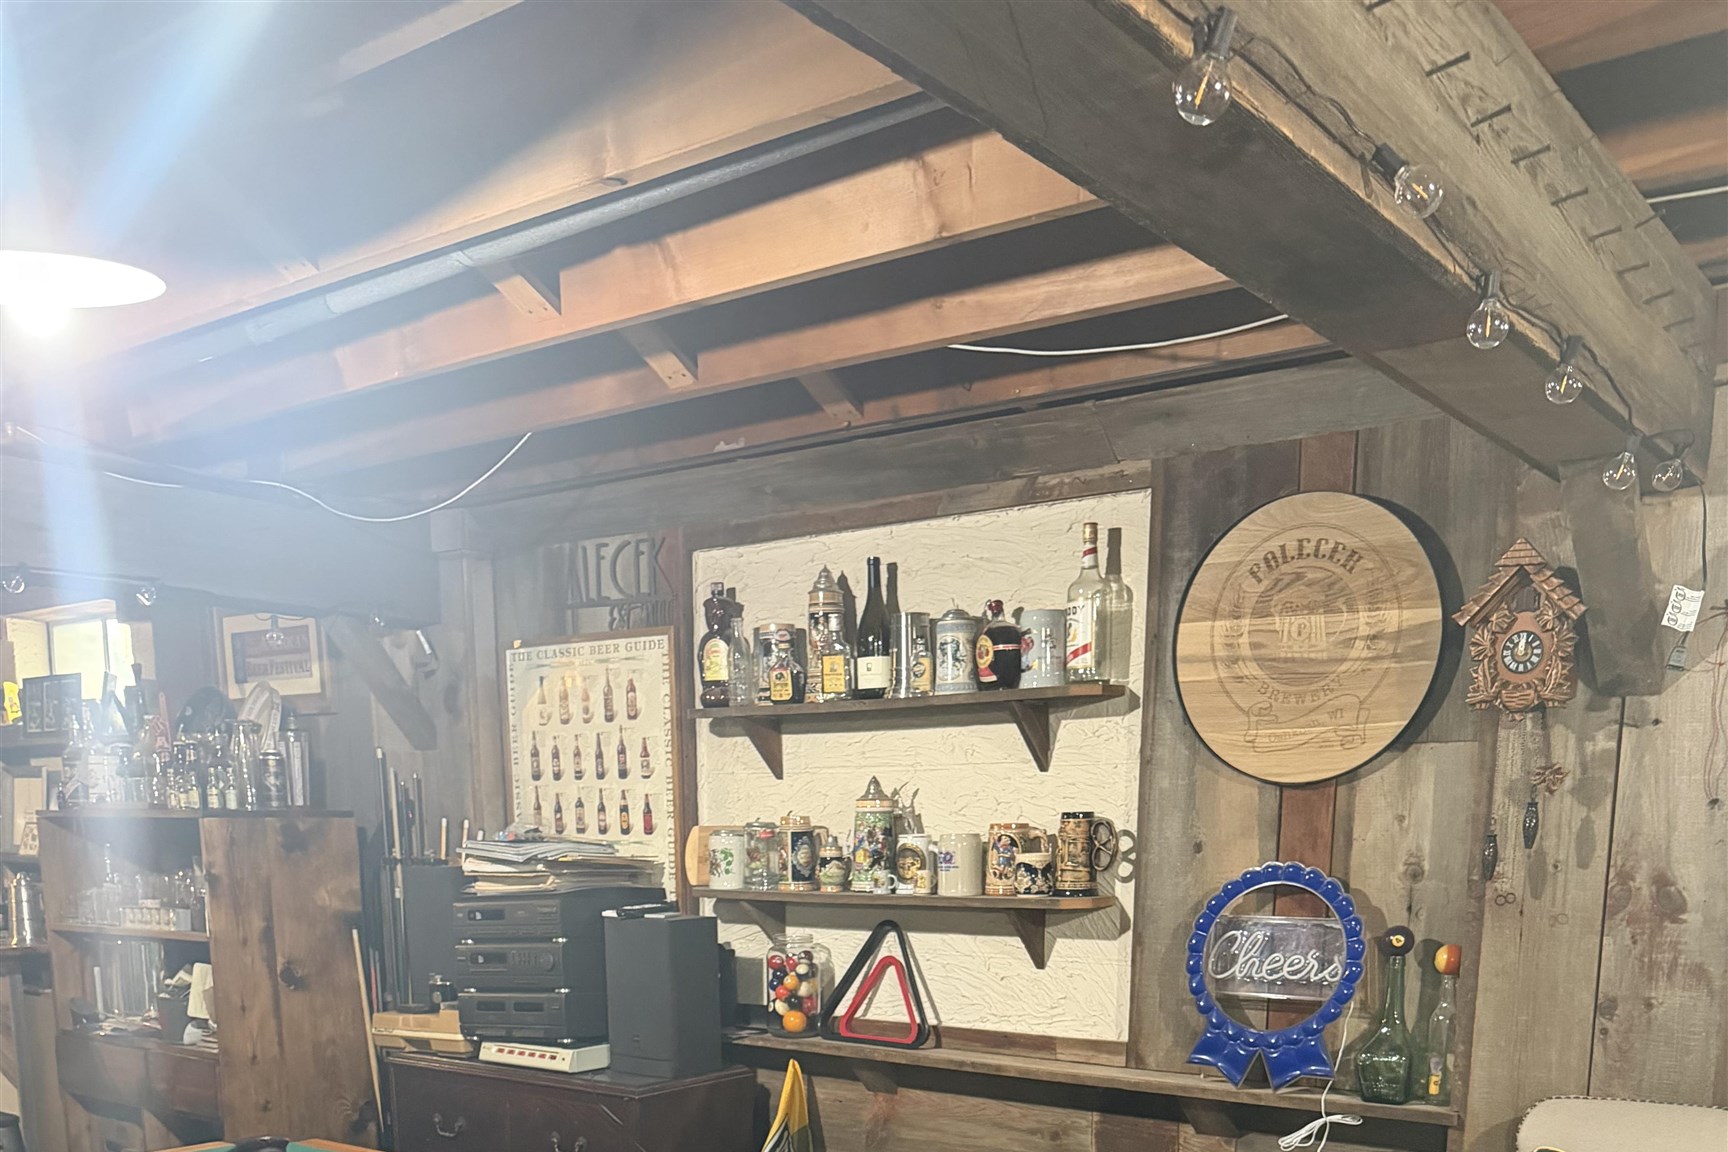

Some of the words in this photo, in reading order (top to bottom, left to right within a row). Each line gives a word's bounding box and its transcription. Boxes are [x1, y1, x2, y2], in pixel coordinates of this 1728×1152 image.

[536, 645, 585, 660] CLASSIC
[589, 642, 620, 656] BEER
[624, 638, 665, 653] GUIDE
[662, 693, 673, 767] CLASSIC
[665, 776, 675, 819] BEER
[666, 828, 677, 880] GUIDE
[1208, 929, 1343, 985] Cheers
